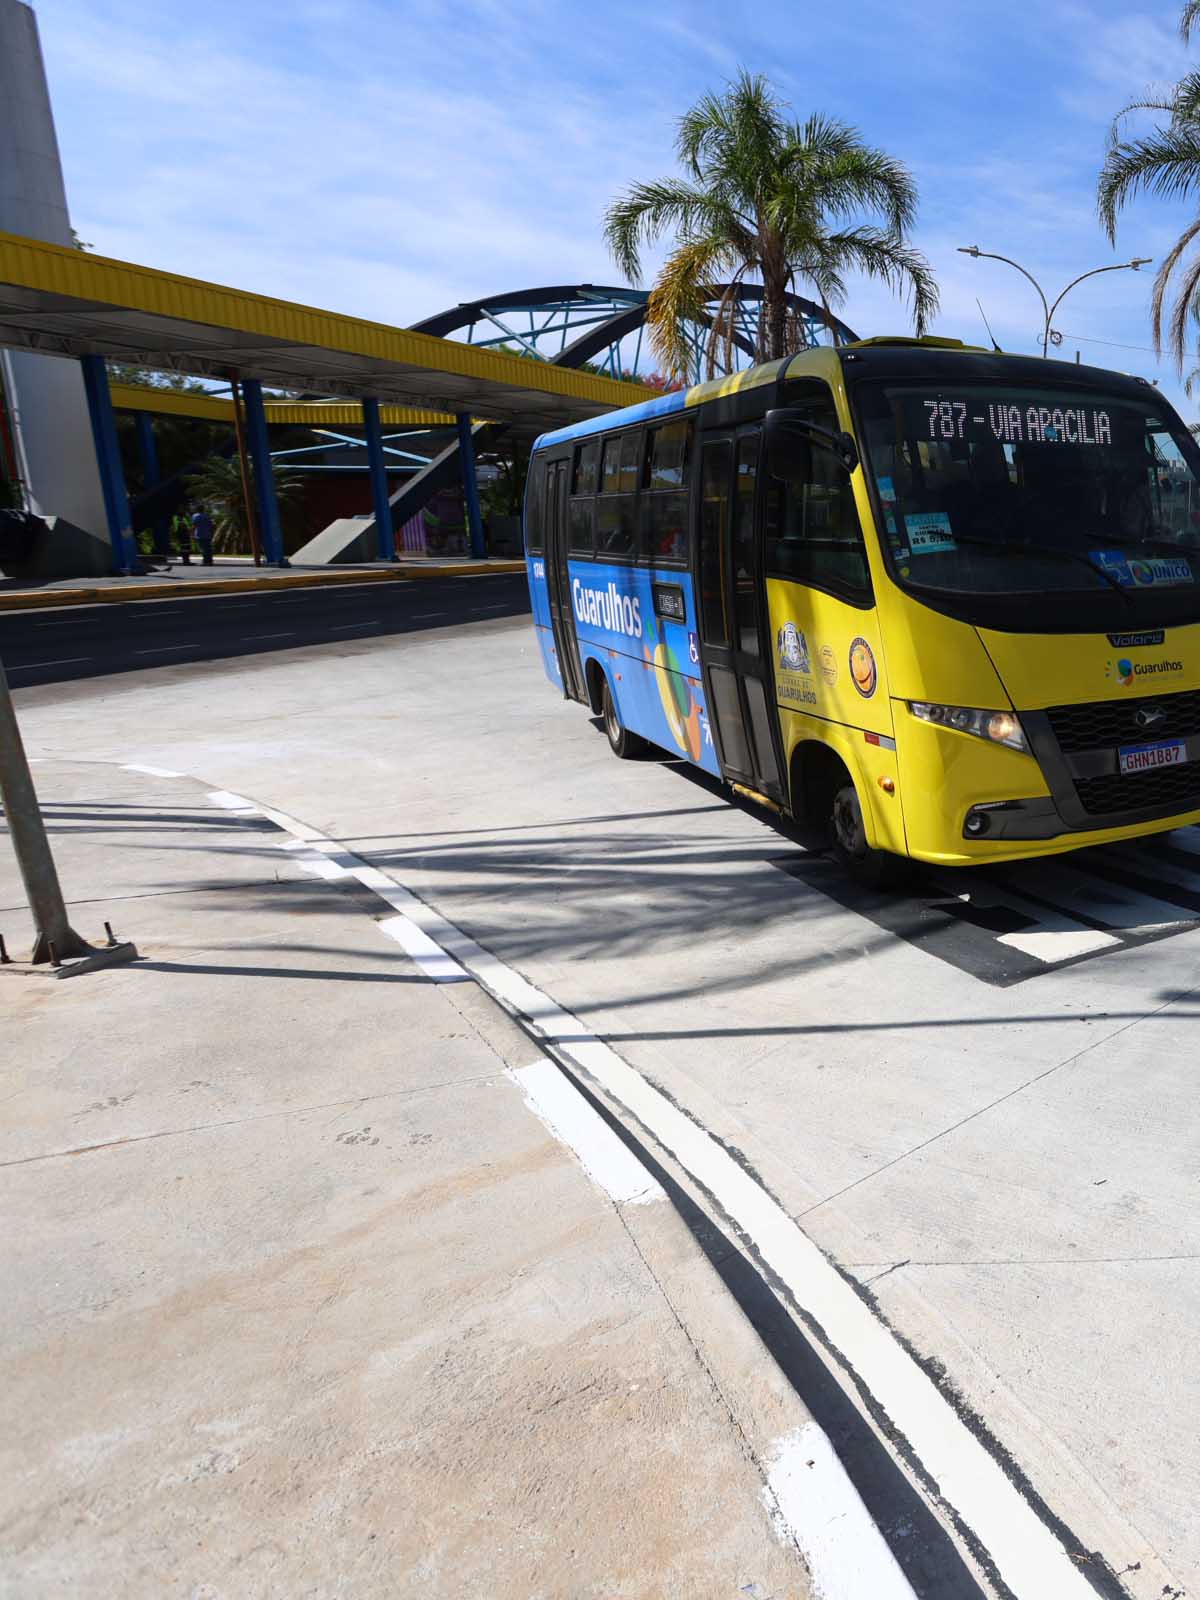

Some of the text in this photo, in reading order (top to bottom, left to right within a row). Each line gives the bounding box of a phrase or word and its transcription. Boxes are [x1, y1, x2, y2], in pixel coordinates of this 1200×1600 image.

[923, 400, 967, 437] 787
[988, 404, 1023, 440] VIA
[1026, 407, 1112, 444] ARACILIA
[573, 578, 642, 638] Guarulhos
[1134, 660, 1183, 675] Guarulhos
